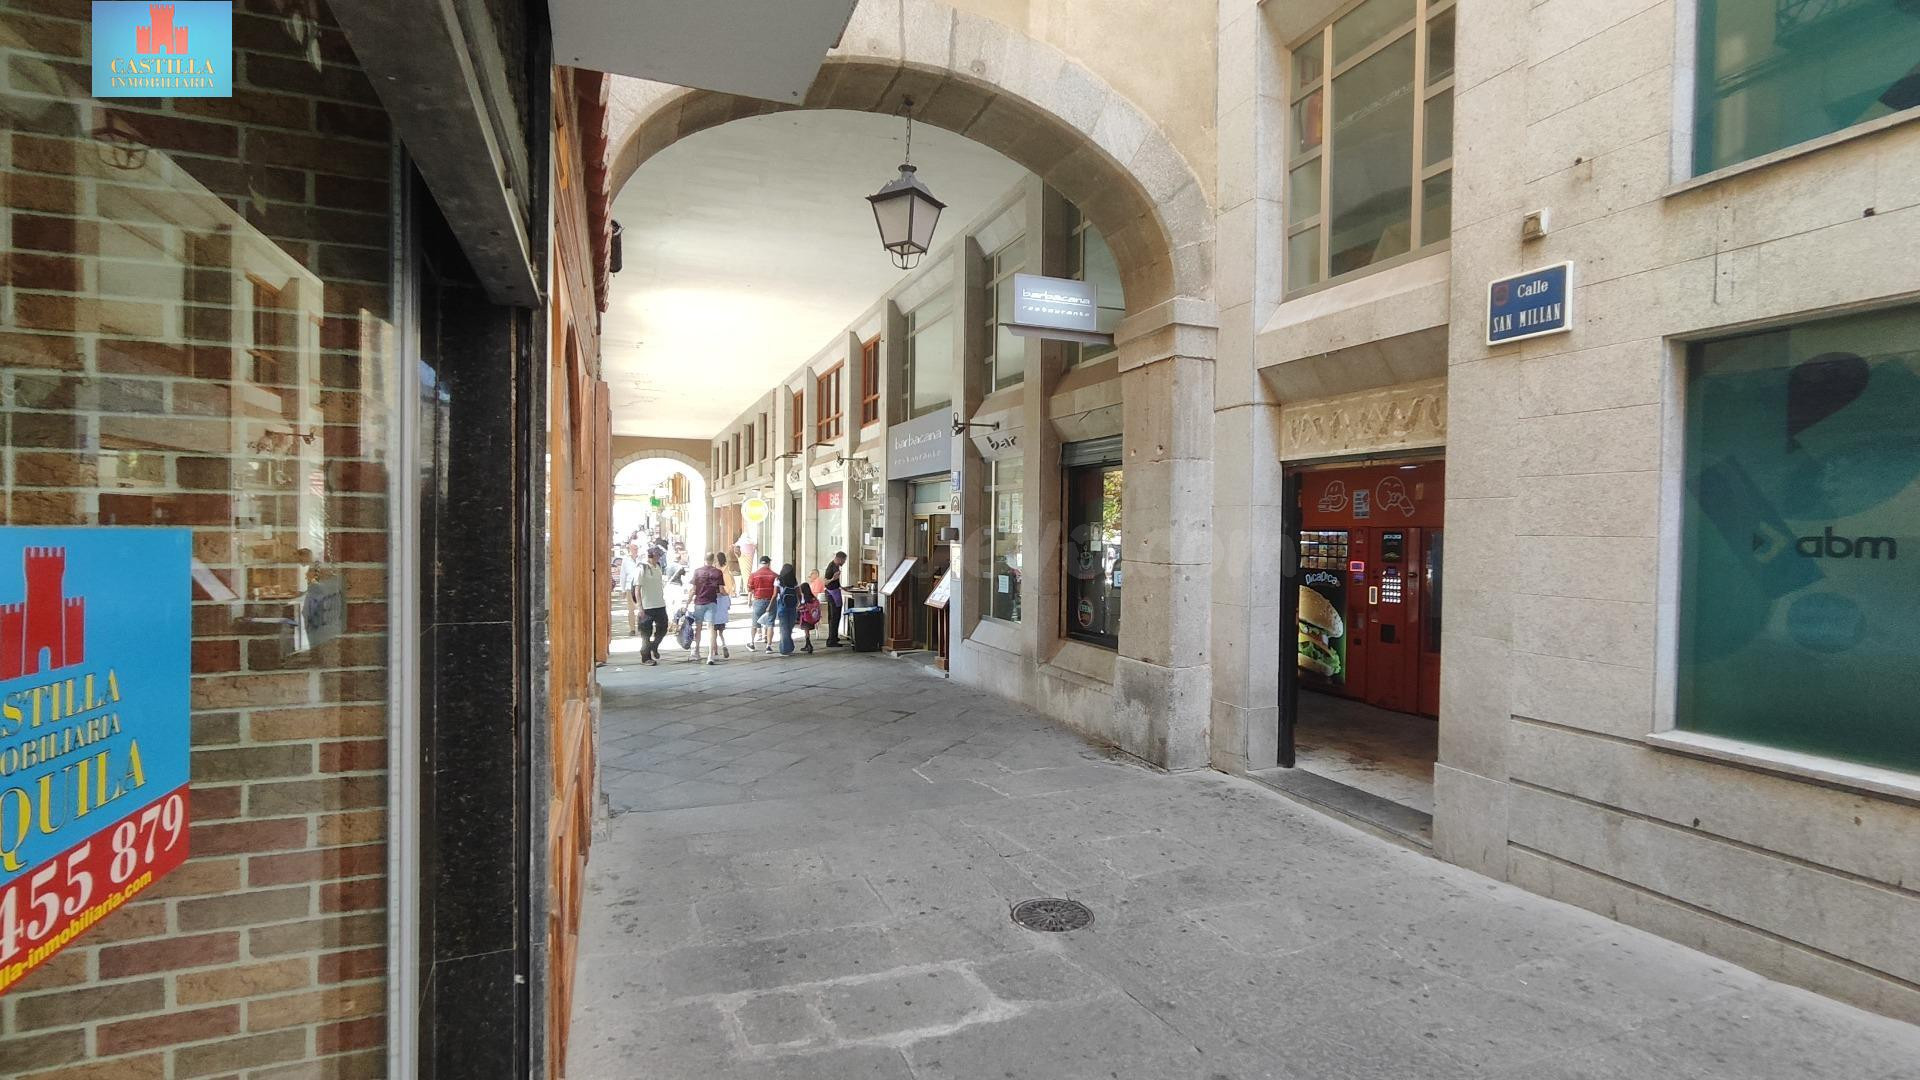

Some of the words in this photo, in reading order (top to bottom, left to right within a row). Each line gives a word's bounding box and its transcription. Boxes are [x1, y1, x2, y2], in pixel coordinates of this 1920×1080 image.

[1517, 280, 1549, 297] Calle
[1493, 314, 1512, 333] SAN
[1519, 303, 1561, 327] MILLAN
[895, 429, 942, 450] barbacana
[986, 435, 1018, 451] bar
[1796, 526, 1897, 561] abm
[110, 794, 184, 884] 879
